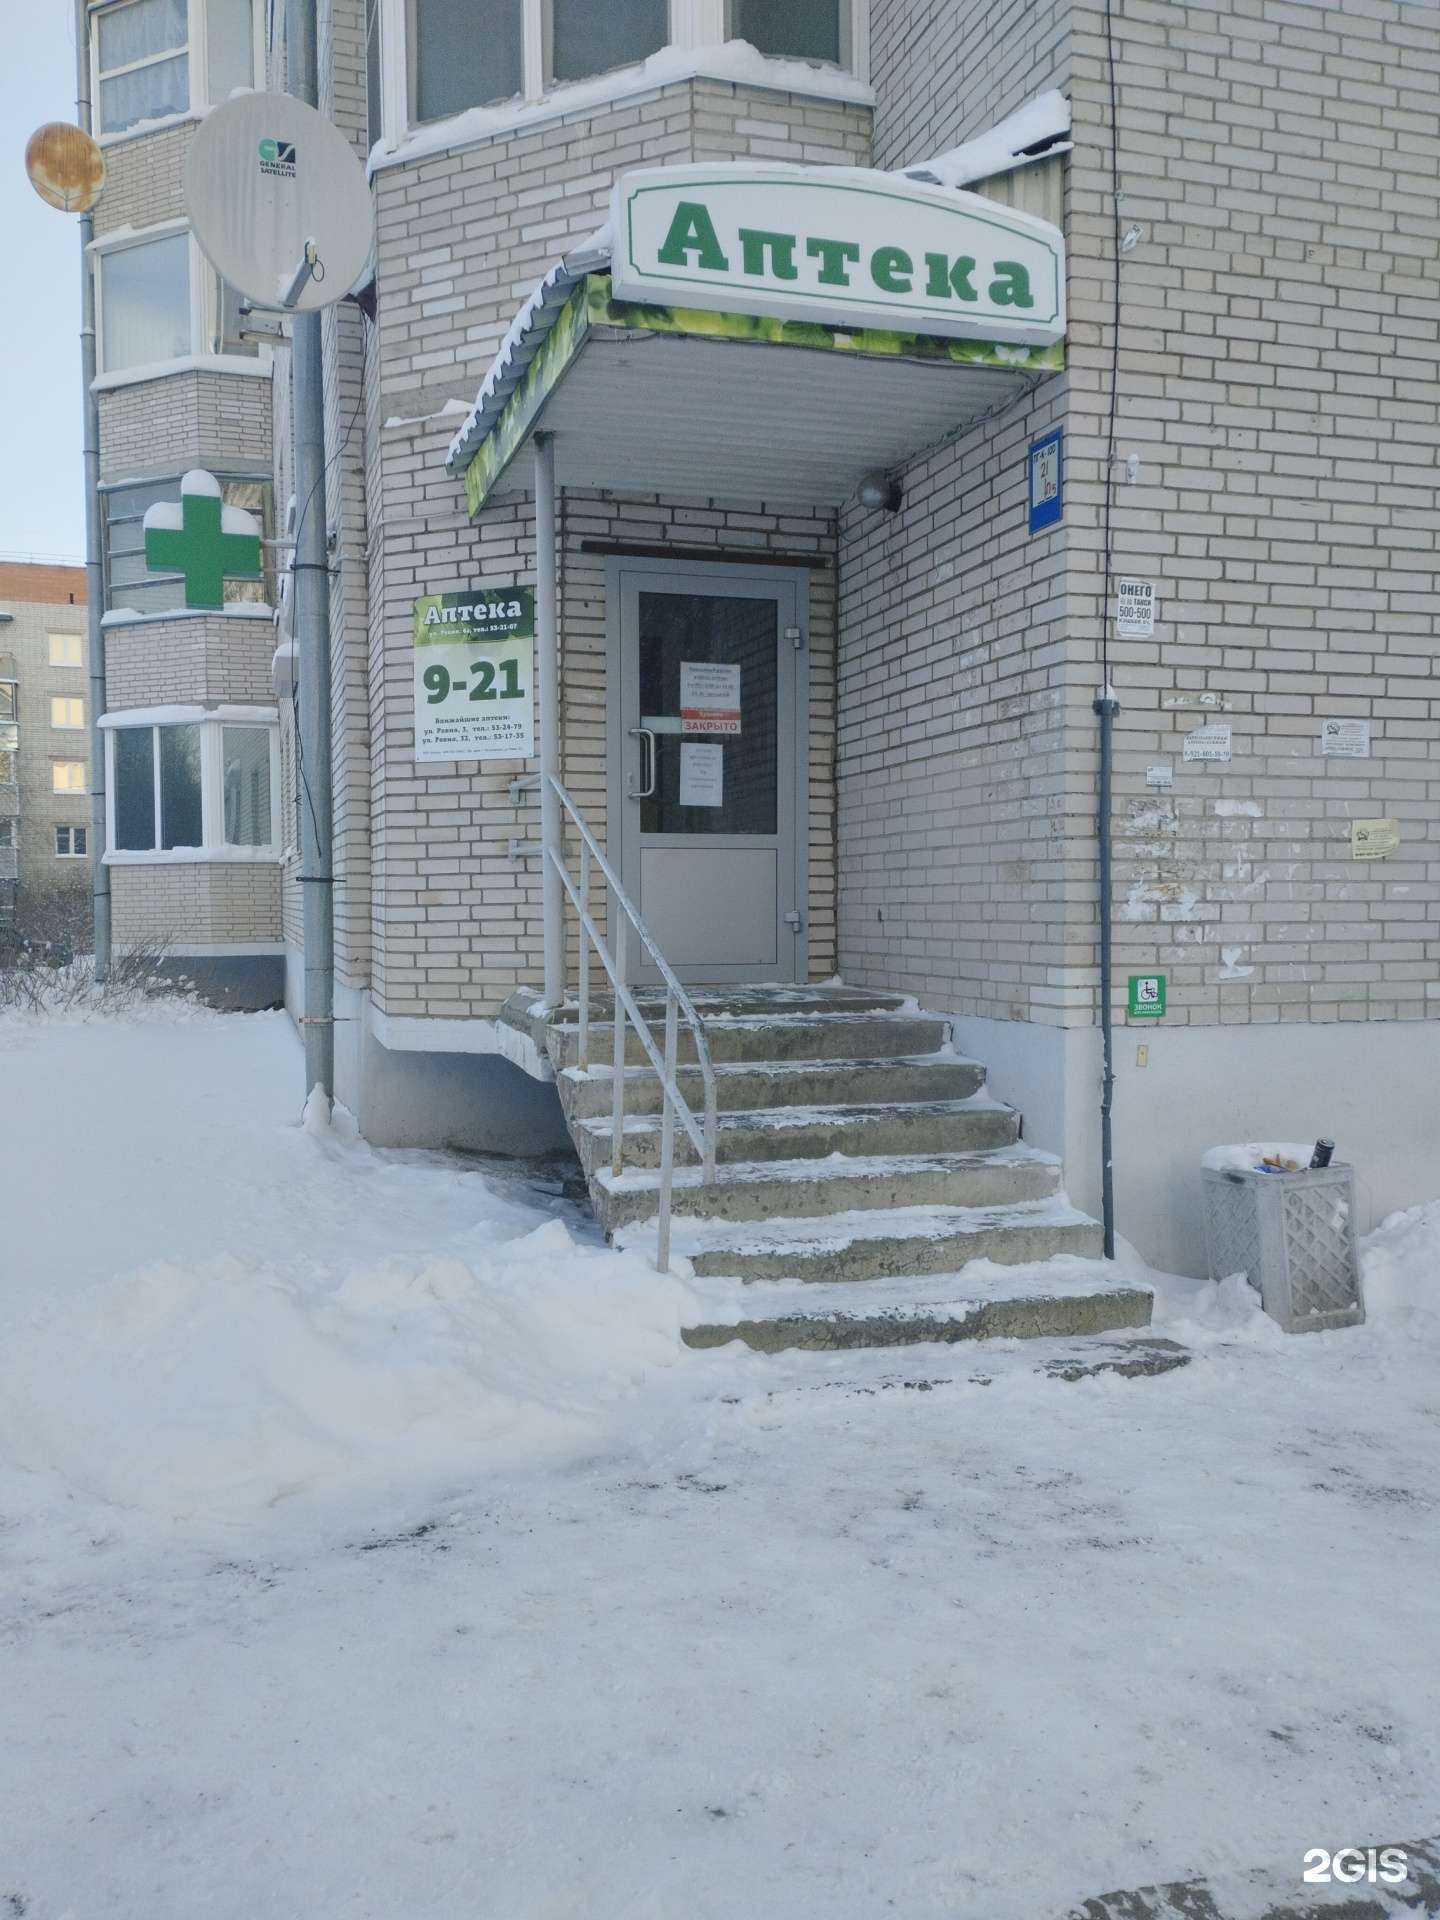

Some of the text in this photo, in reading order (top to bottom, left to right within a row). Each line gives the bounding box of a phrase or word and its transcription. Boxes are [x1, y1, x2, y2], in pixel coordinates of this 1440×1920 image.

[260, 160, 295, 171] GENERAL
[261, 167, 296, 178] SATELLITE
[657, 201, 1035, 308] Аптека
[1120, 583, 1152, 597] ОНЕГО
[424, 600, 522, 625] Аптека
[1119, 605, 1152, 620] 500-500
[423, 658, 526, 705] 9-21
[684, 721, 738, 731] ЗАКРЫТО
[474, 734, 492, 742] тел.:
[1133, 1002, 1163, 1011] ЗВОНОК
